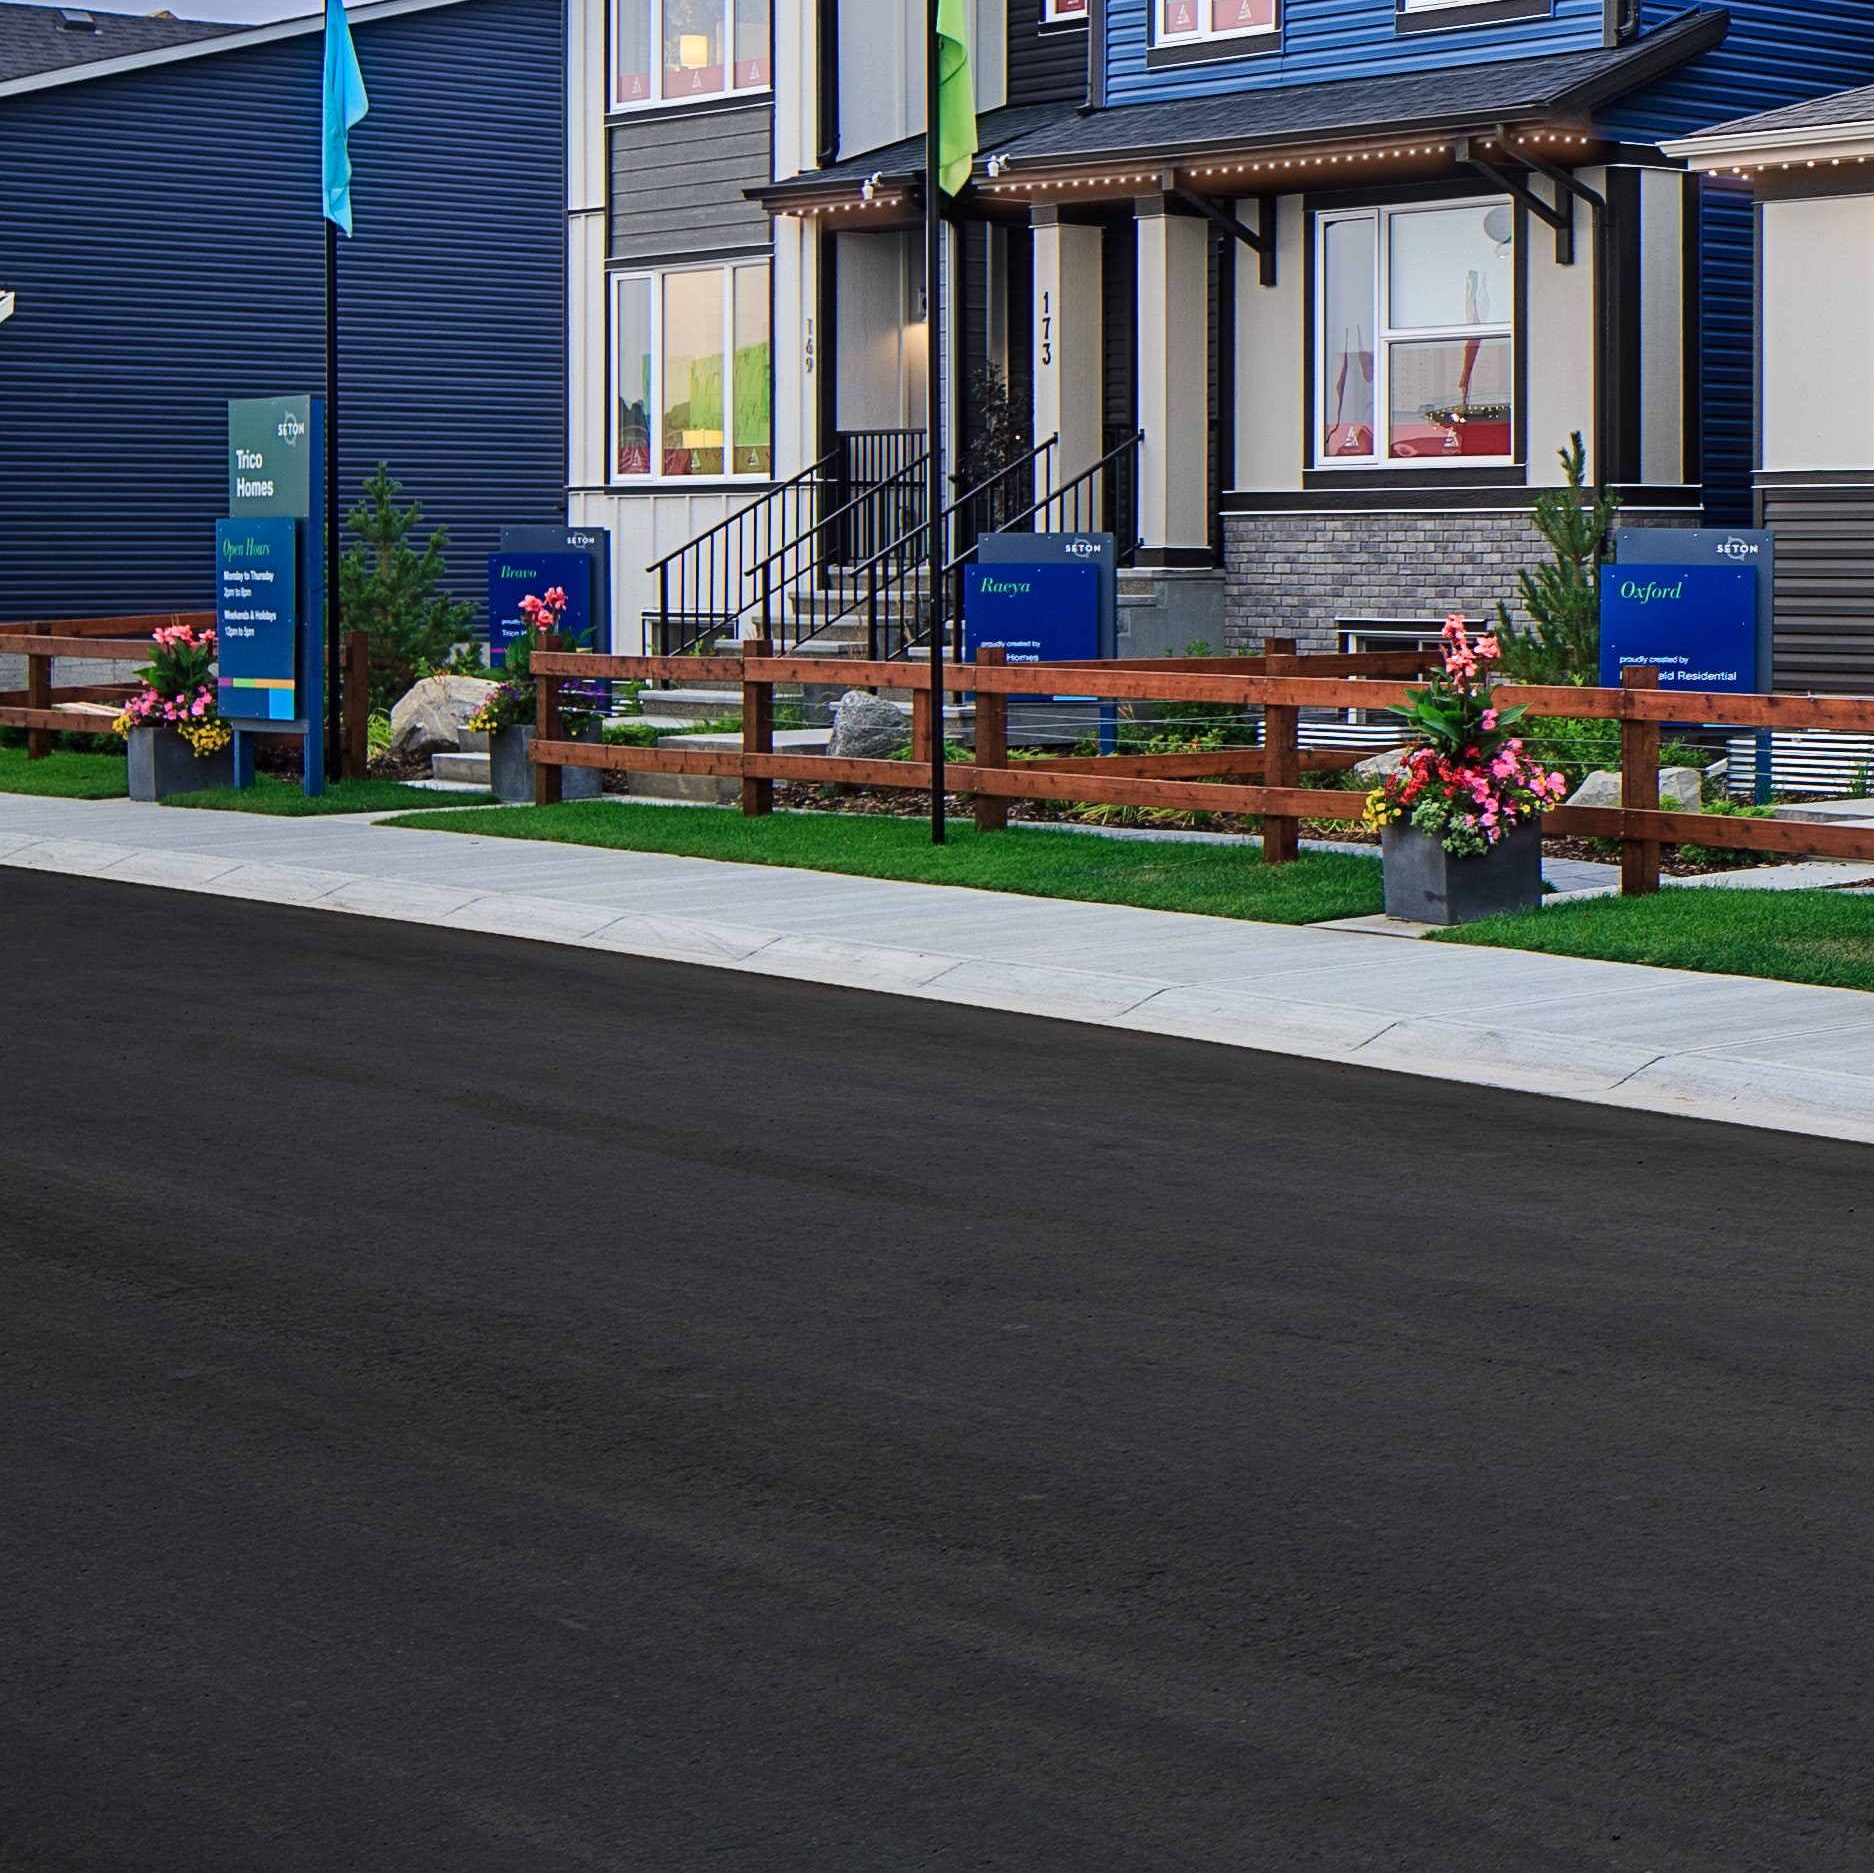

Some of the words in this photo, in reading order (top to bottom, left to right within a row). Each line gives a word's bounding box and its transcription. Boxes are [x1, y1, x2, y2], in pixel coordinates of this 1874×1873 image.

[1042, 291, 1051, 365] 173
[806, 318, 814, 374] 169
[277, 422, 305, 436] SETON
[235, 449, 263, 469] Trico
[236, 477, 274, 497] Homes
[222, 538, 244, 562] Open
[246, 537, 270, 556] Hours
[1065, 544, 1101, 553] SETON
[1716, 544, 1759, 554] SETON
[250, 570, 275, 583] Thursday
[501, 566, 537, 578] Bravo
[980, 577, 1031, 597] Raeya
[1620, 581, 1683, 604] Oxford
[1006, 654, 1039, 662] Homes
[1619, 655, 1648, 665] proudly
[1678, 656, 1689, 665] by
[1677, 671, 1737, 681] Residential
